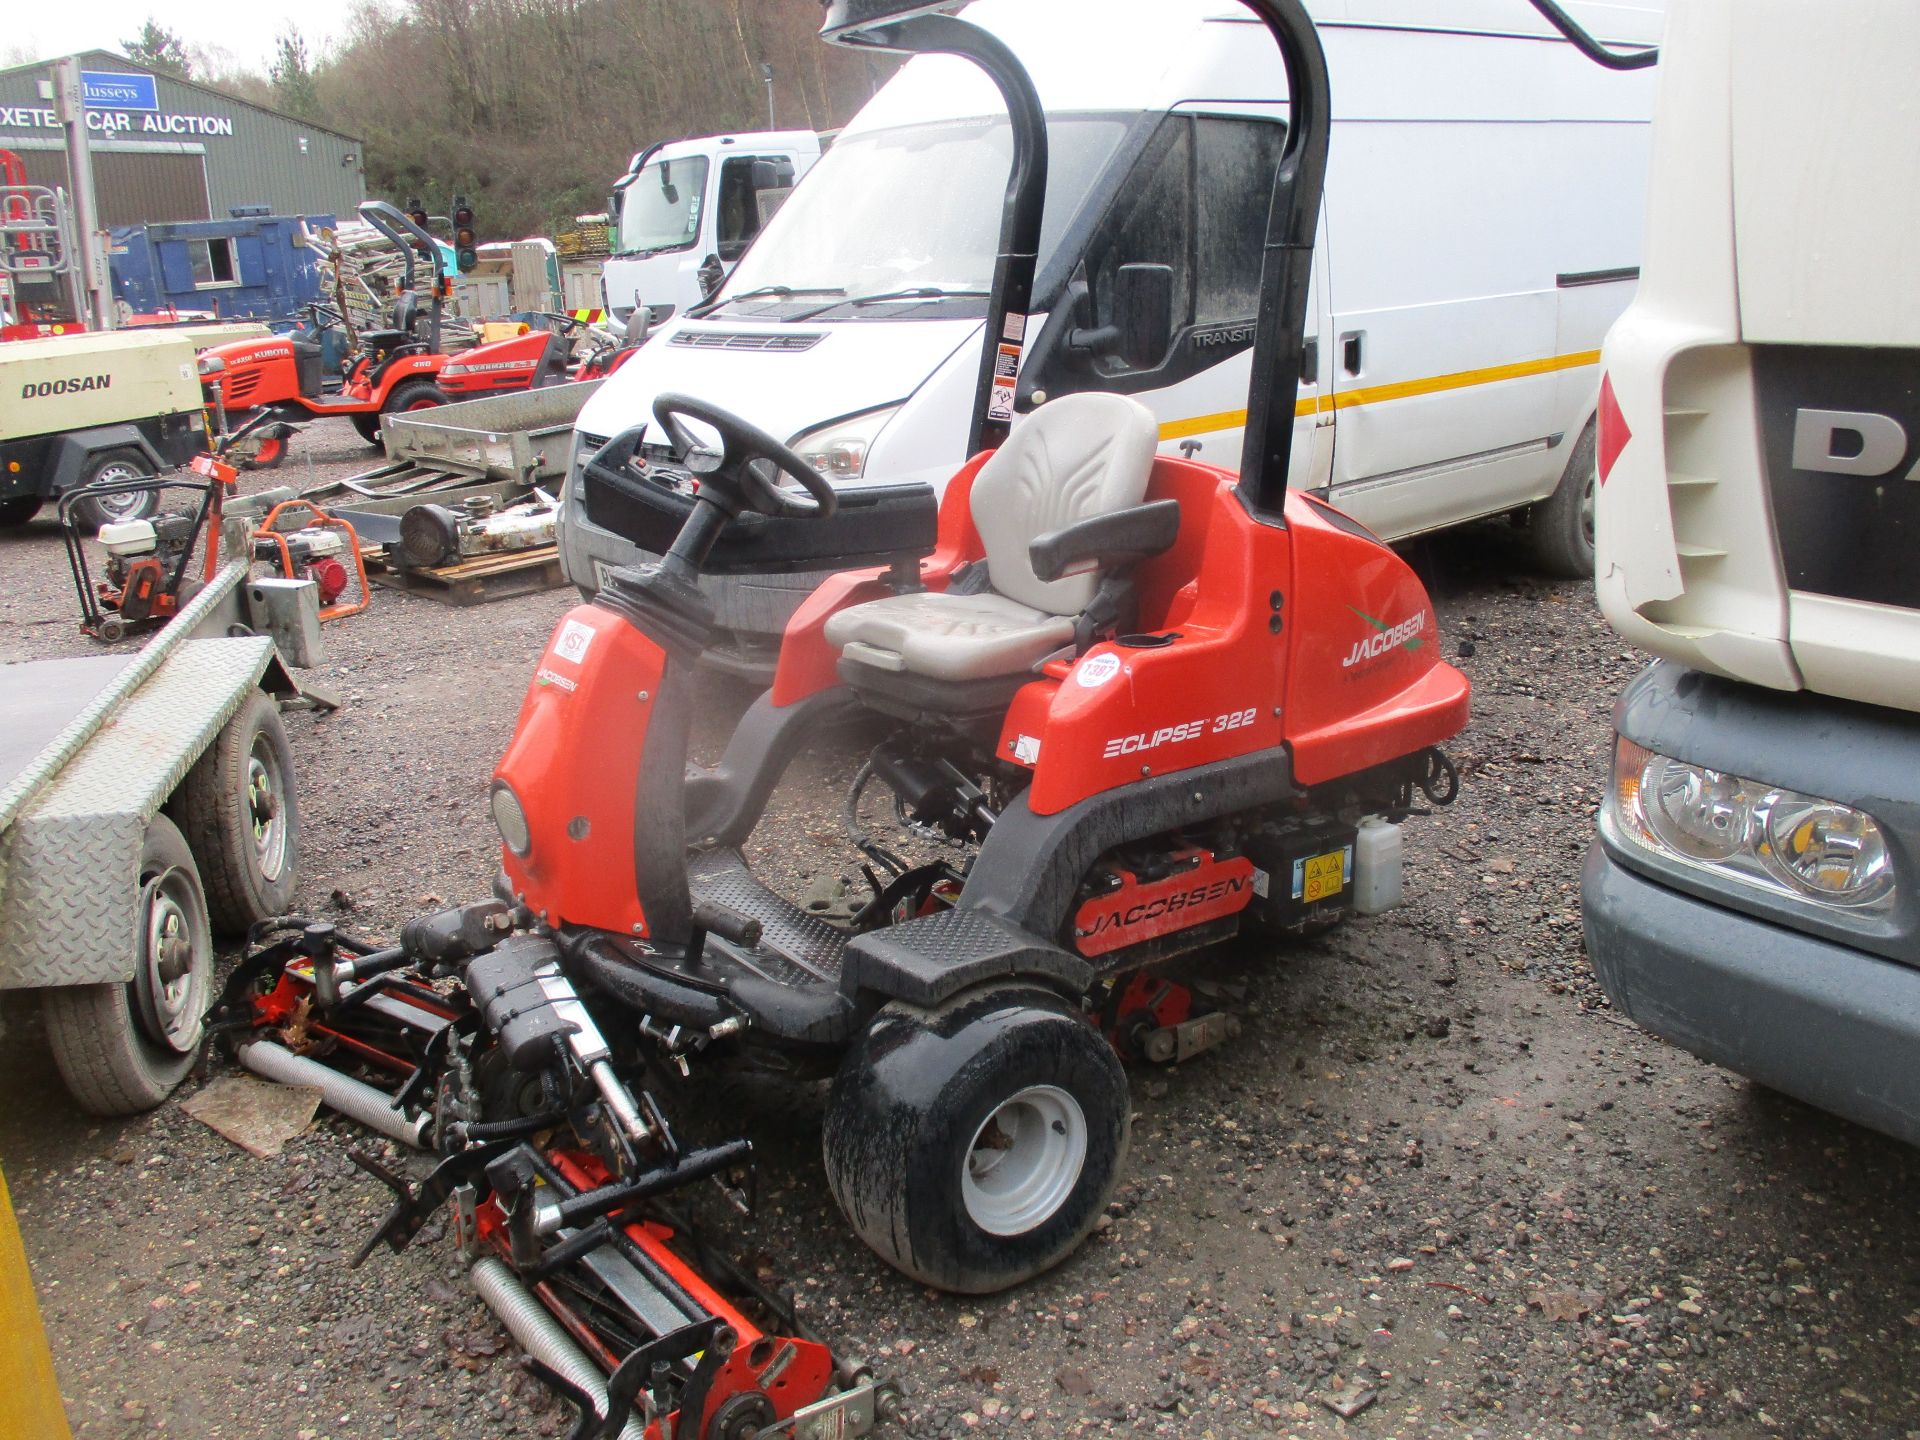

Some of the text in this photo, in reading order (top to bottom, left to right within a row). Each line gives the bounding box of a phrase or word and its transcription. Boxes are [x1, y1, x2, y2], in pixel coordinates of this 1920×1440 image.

[86, 111, 131, 131] CAR
[143, 115, 233, 136] AUCTION
[1193, 328, 1255, 347] TRANSIT
[254, 348, 290, 359] KUBOTA
[22, 374, 111, 399] DOOSAN
[1342, 609, 1426, 667] JACOBSEN
[536, 669, 579, 692] JACOBSEN
[1103, 708, 1257, 758] ECLIPSE 322
[1082, 874, 1248, 936] JACOBSEN
